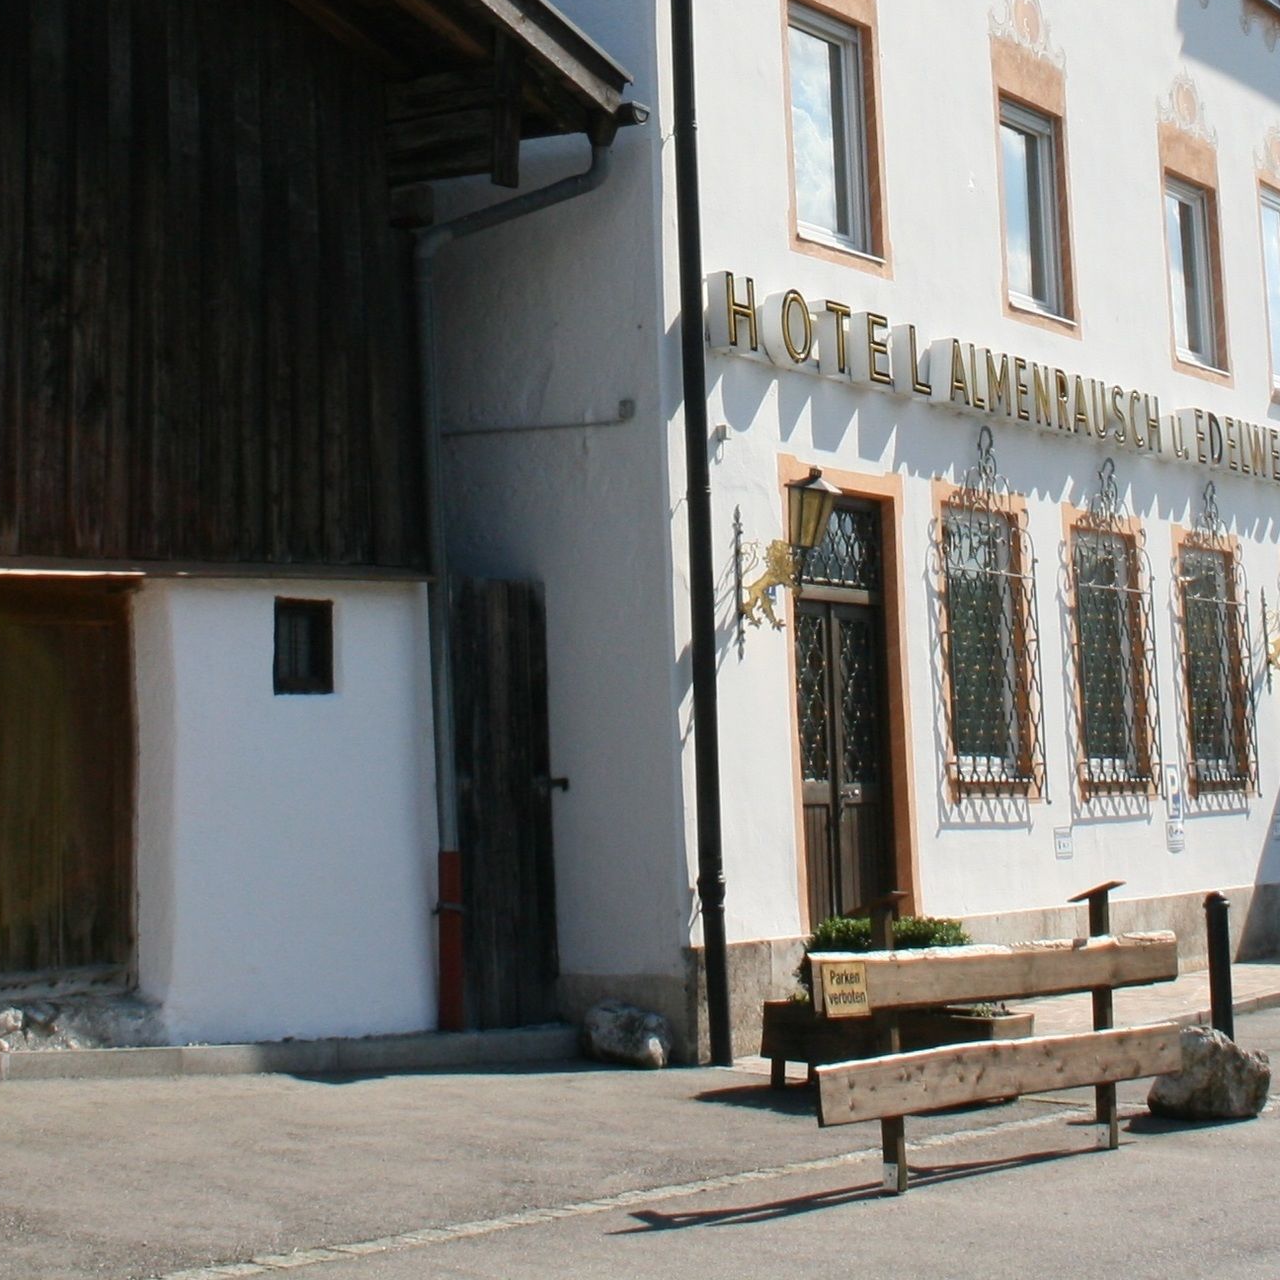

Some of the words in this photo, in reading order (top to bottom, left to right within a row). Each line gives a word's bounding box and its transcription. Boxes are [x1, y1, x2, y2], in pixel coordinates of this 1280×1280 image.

[722, 269, 932, 396] HOTEL
[949, 337, 1163, 455] ALMENRAUSCH
[829, 969, 860, 985] Parken
[828, 989, 866, 1005] verboten
